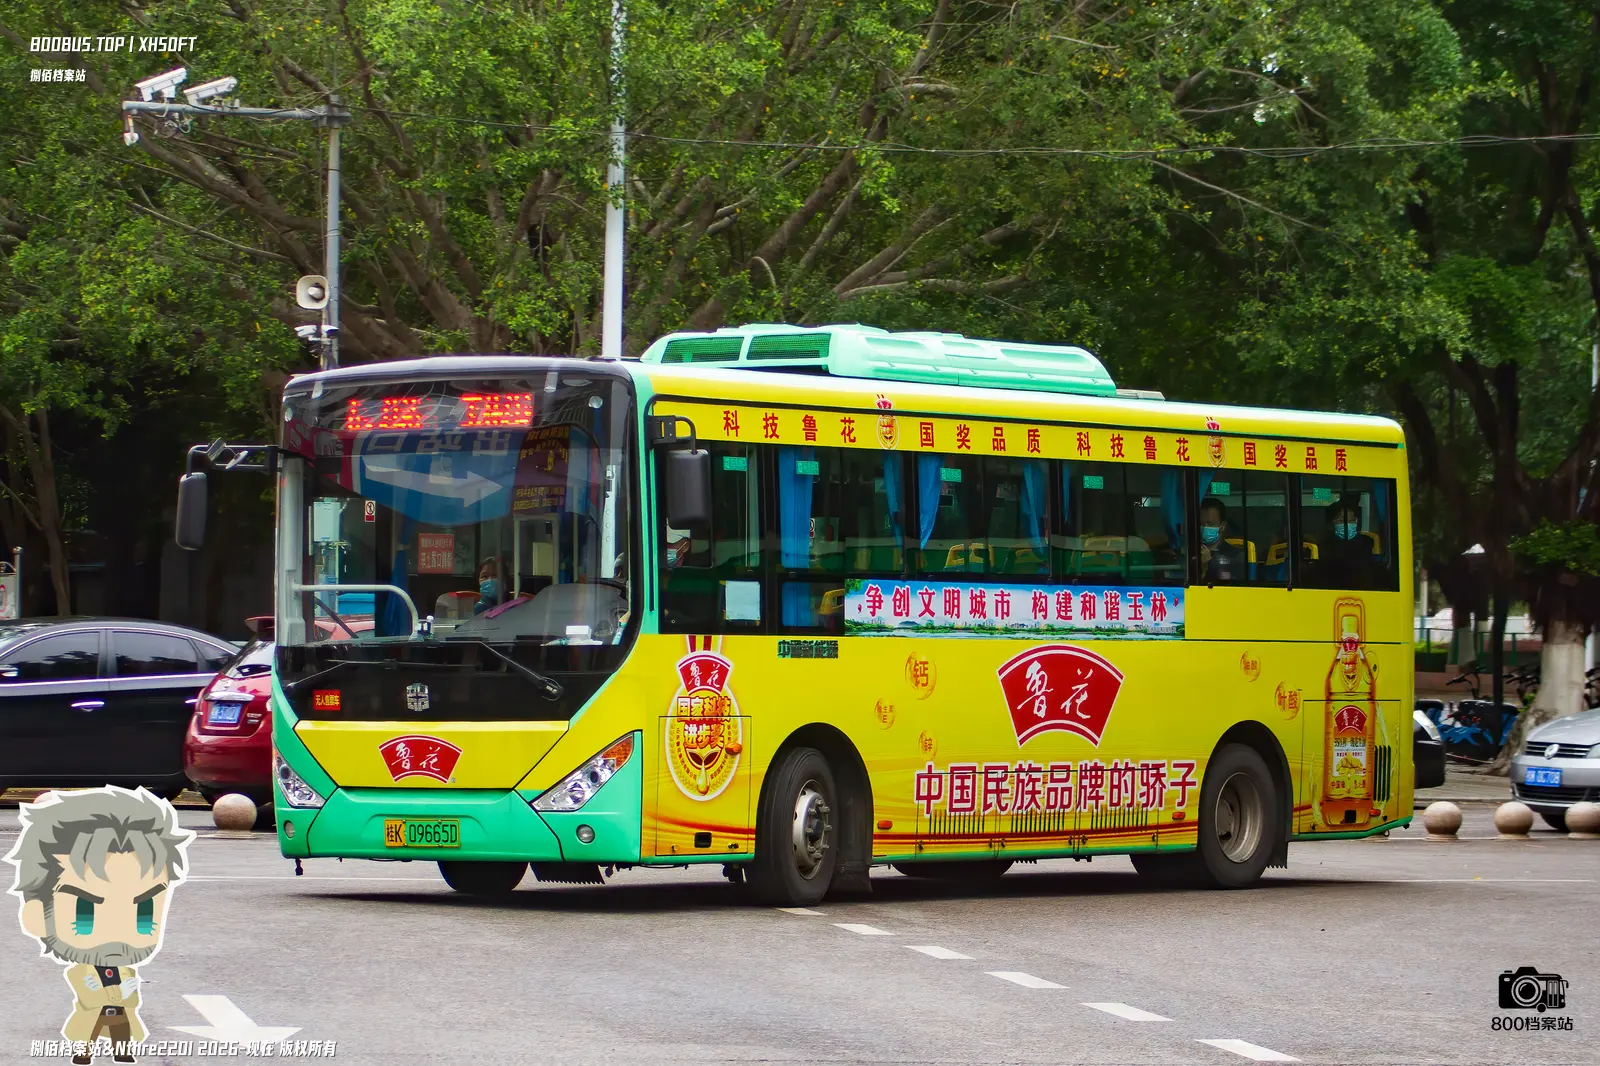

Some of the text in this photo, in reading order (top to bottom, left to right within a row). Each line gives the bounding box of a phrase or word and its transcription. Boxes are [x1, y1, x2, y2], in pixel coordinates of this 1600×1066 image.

[723, 410, 856, 443] 科技鲁花
[920, 422, 1041, 454] 国奖品质
[1076, 431, 1190, 462] 科技鲁花
[1244, 442, 1348, 472] 国奖品质
[865, 584, 1167, 621] 争创文明城市 构建和谐玉林
[688, 662, 720, 688] 鲁花
[913, 660, 929, 687] 钙
[1017, 660, 1091, 719] 鲁花
[677, 697, 731, 722] 国家科技
[684, 724, 724, 749] 进步奖
[391, 742, 440, 770] 鲁花
[915, 760, 1197, 816] 中国民族品牌的骄子
[408, 824, 458, 843] 09665D
